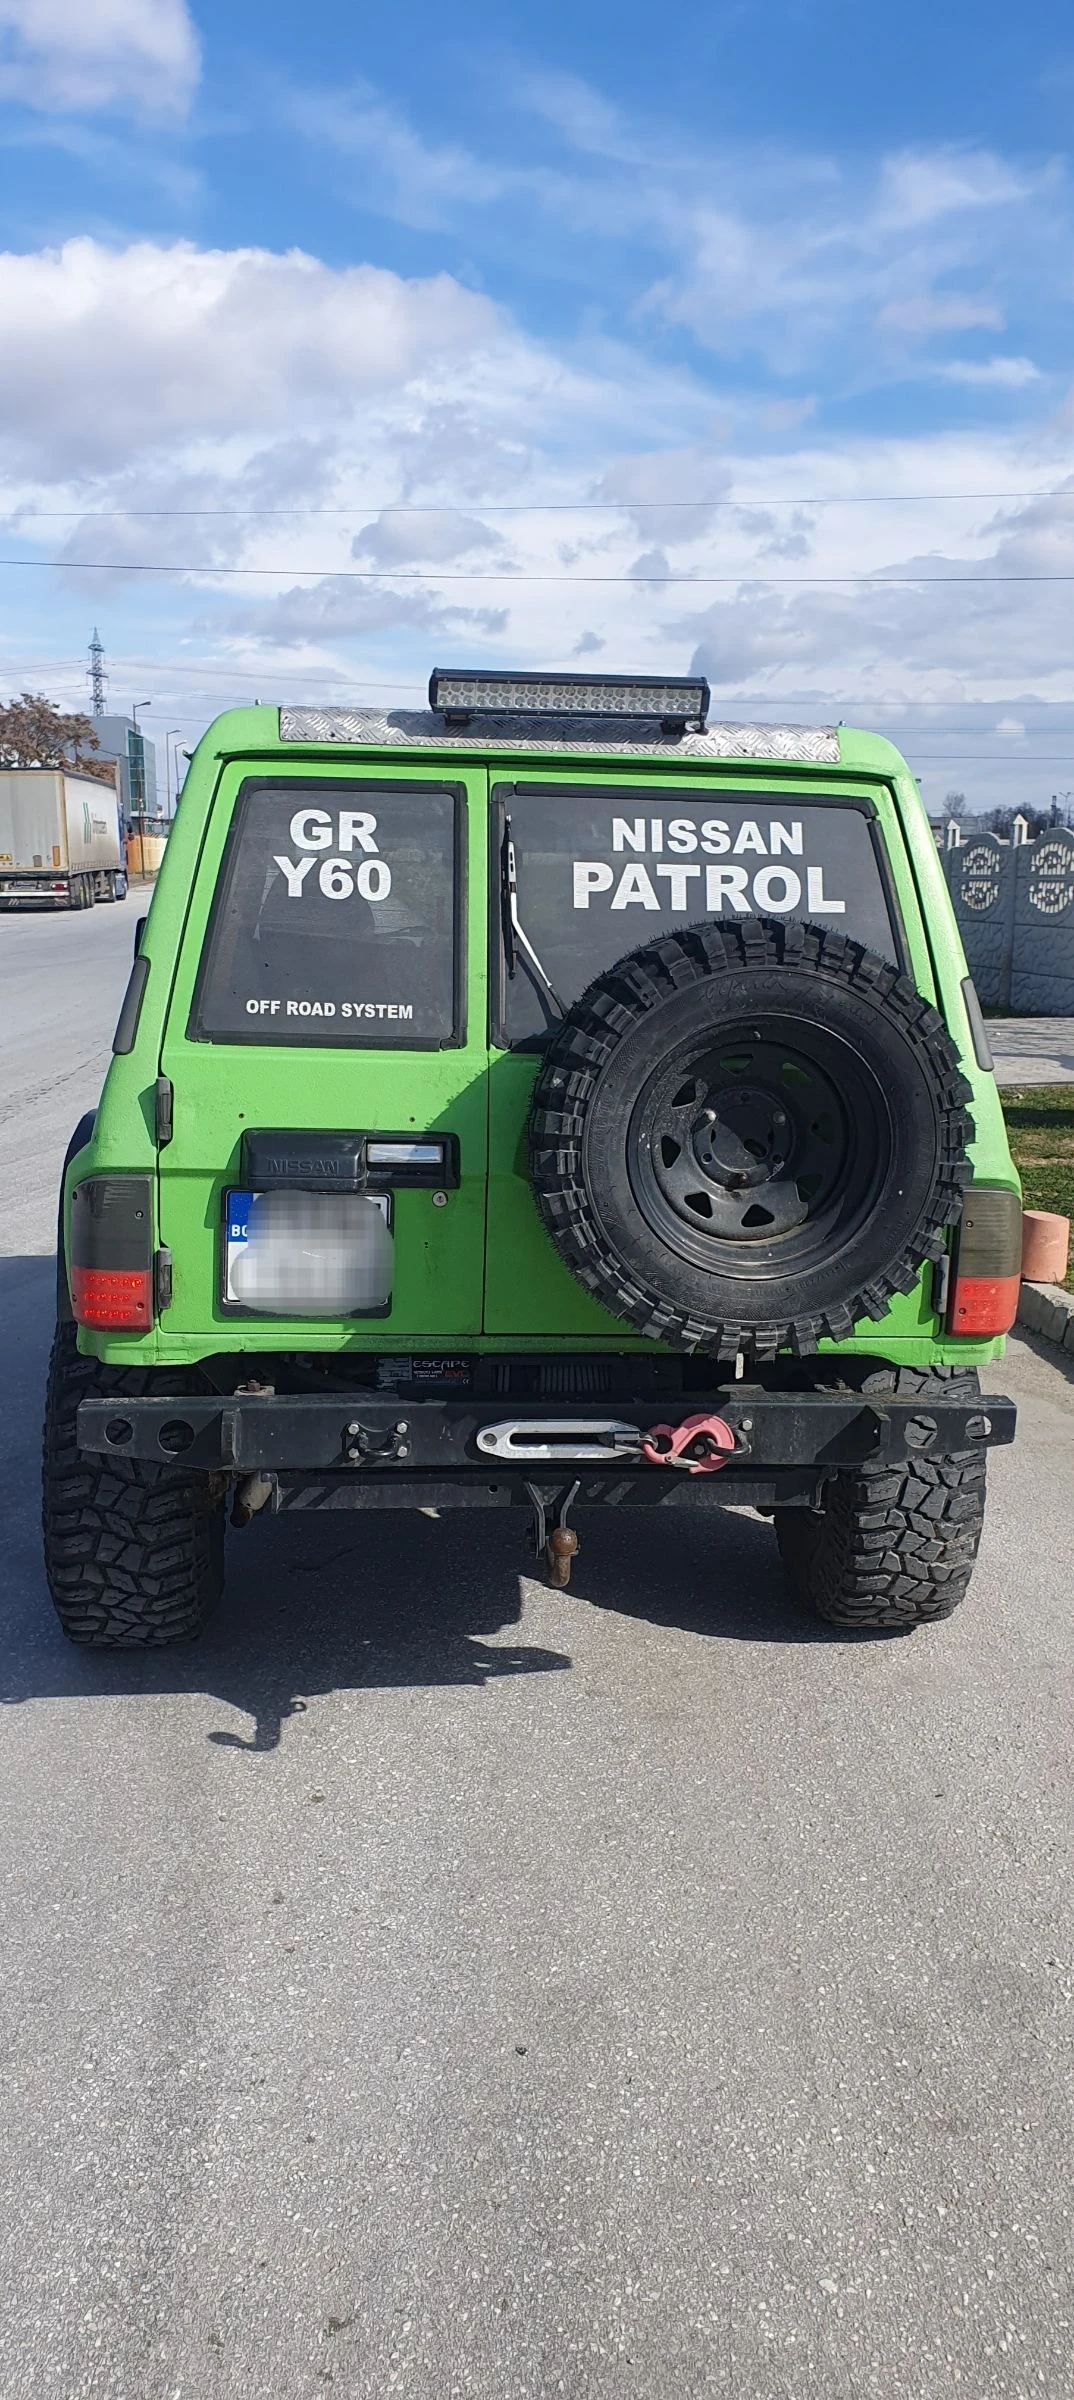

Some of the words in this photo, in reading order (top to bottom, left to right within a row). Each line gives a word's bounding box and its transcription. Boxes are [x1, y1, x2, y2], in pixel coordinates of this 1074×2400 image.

[290, 809, 380, 853] GR
[612, 817, 804, 856] NISSAN
[273, 855, 392, 902] Y60
[573, 861, 846, 914] PATROL
[246, 999, 281, 1015] OFF
[286, 1000, 335, 1017] ROAD
[341, 1002, 413, 1019] SYSTEM
[413, 1360, 470, 1370] ESCAPE
